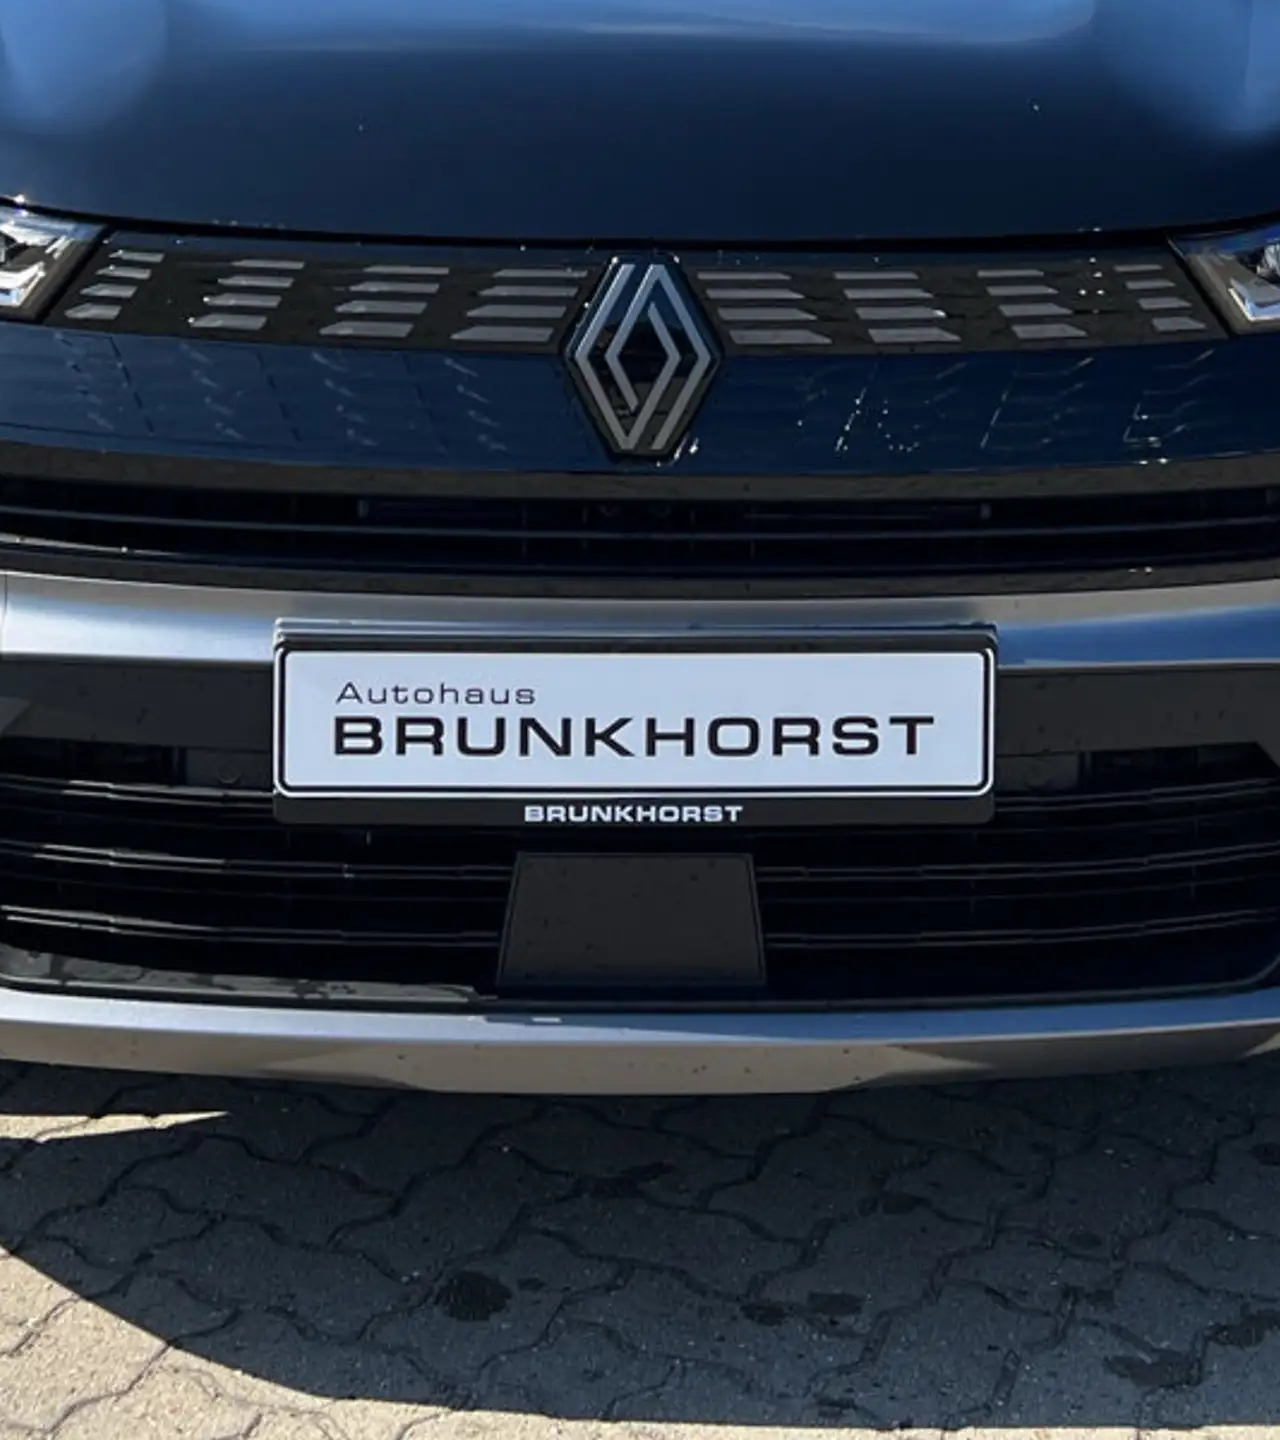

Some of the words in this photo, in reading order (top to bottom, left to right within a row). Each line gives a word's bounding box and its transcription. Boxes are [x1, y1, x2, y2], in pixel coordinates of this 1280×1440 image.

[336, 682, 536, 706] Autohaus
[333, 715, 935, 758] BRUNKHORST
[523, 804, 745, 824] BRUNKHORST
